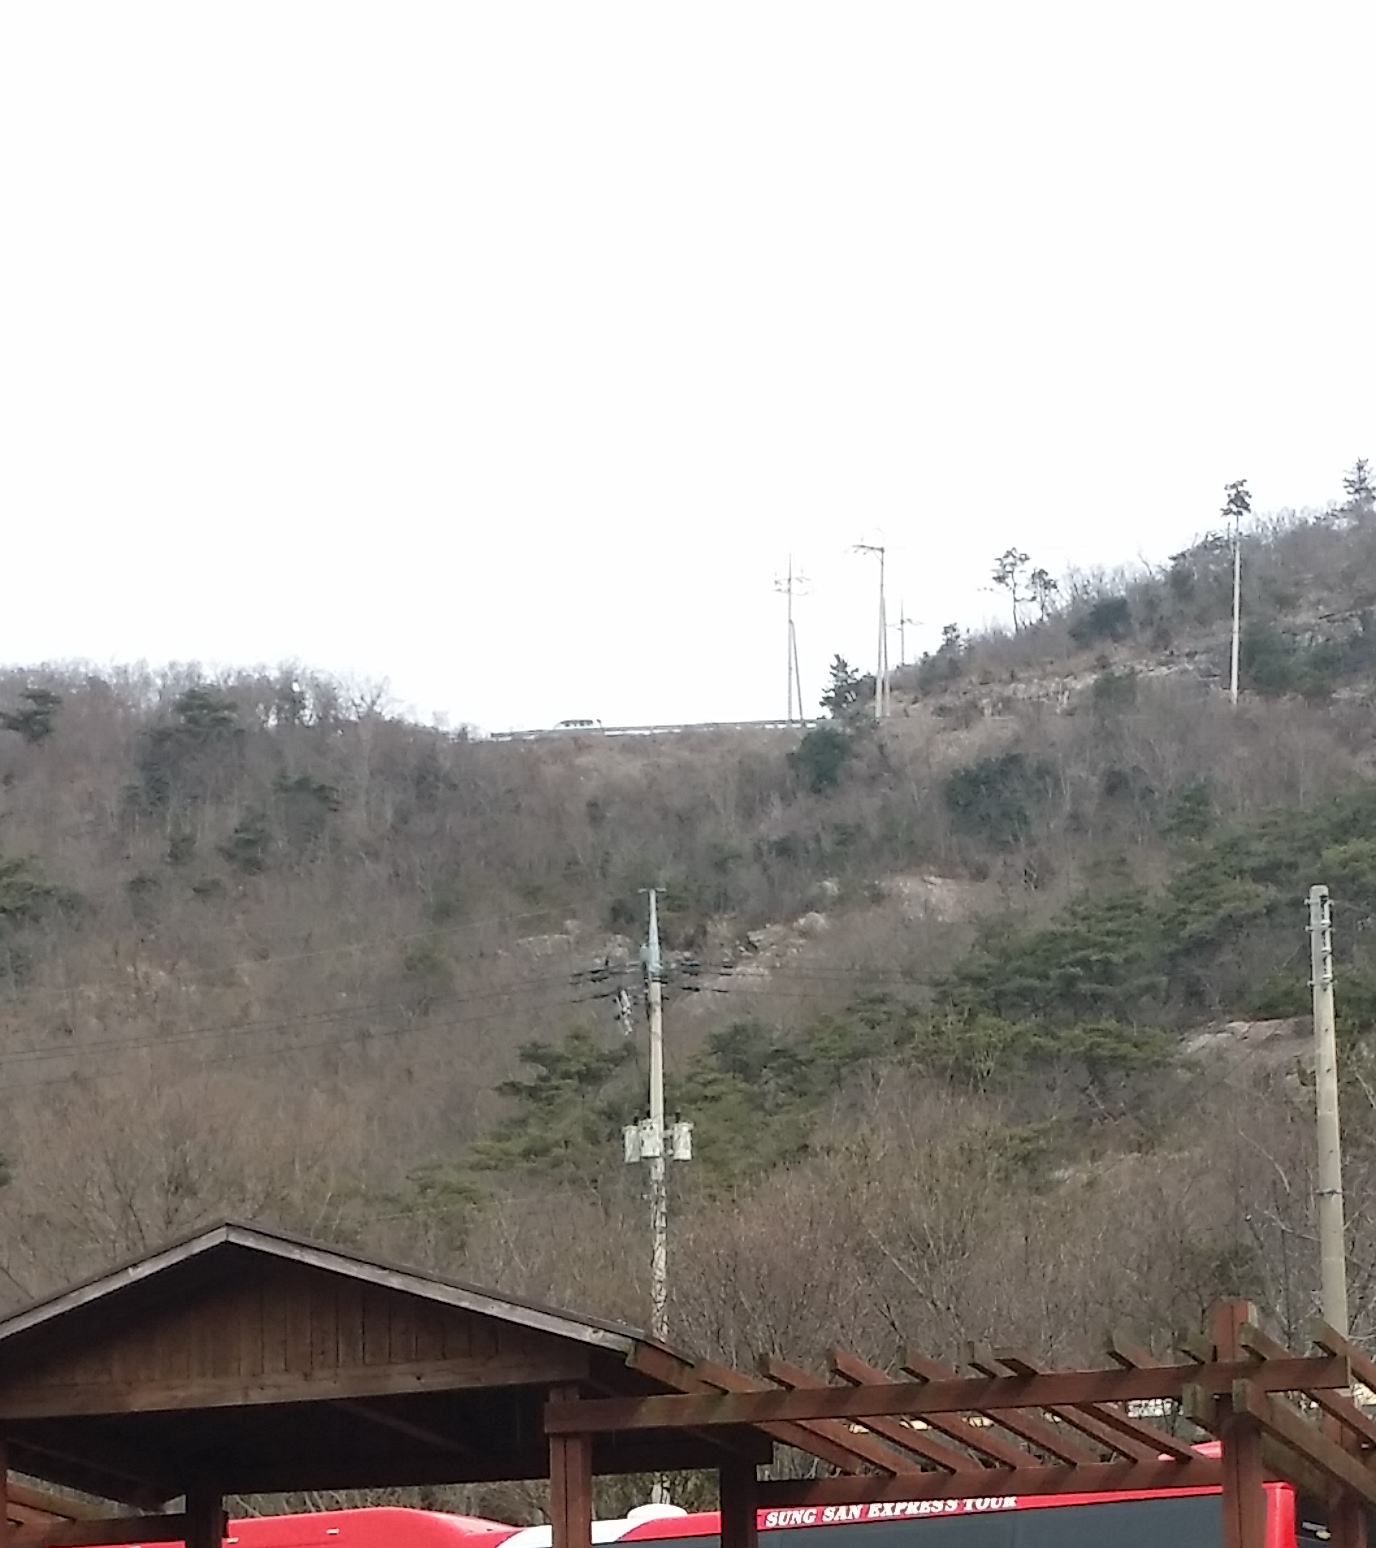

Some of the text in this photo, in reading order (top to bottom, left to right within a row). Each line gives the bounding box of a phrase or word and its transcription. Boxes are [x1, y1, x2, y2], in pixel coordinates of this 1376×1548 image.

[765, 1509, 817, 1527] SUNG
[823, 1504, 864, 1522] SAN
[867, 1499, 959, 1518] EXPRESS
